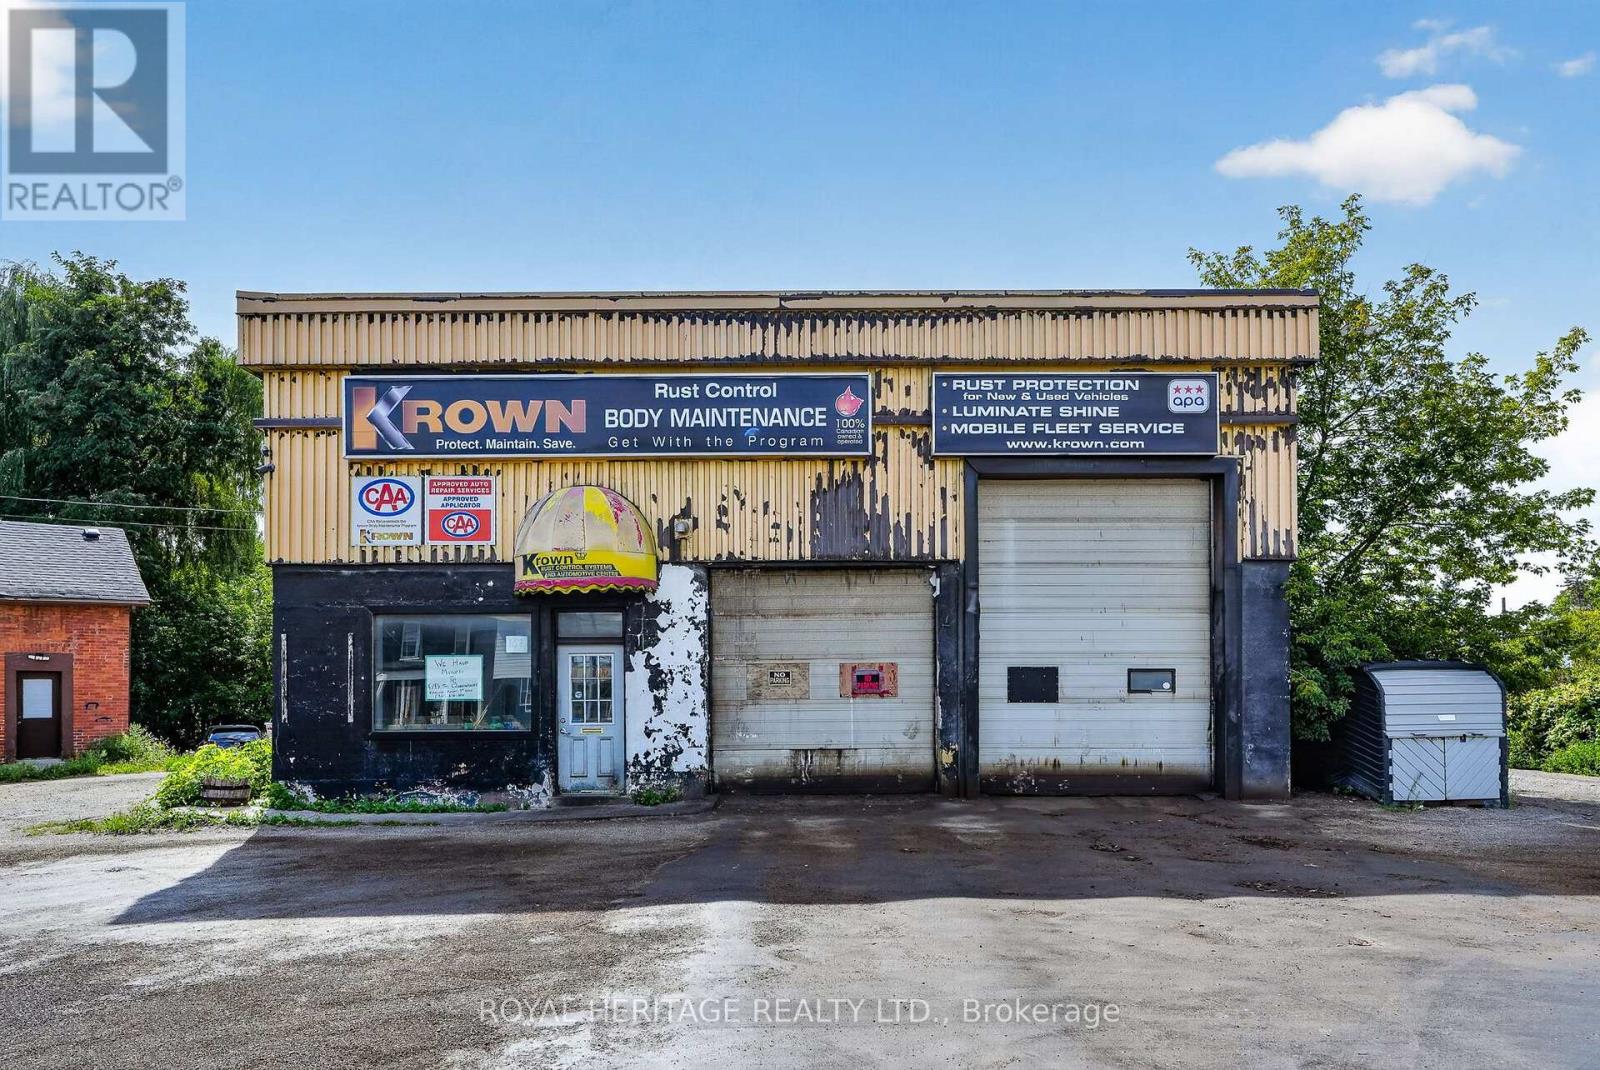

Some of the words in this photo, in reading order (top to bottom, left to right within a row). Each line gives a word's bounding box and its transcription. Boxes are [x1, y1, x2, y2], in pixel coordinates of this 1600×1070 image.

[655, 383, 700, 399] Rust
[705, 383, 777, 399] Control
[952, 380, 1006, 391] RUST
[1013, 379, 1140, 391] PROTECTION
[963, 392, 983, 401] for
[987, 392, 1018, 401] New
[1021, 392, 1032, 401] &
[1036, 392, 1069, 401] Used
[1074, 392, 1129, 401] Vehicles
[1173, 395, 1205, 408] apa
[352, 385, 587, 451] KROWN
[604, 408, 663, 428] BODY
[671, 407, 827, 428] MAINTENANCE
[952, 406, 1052, 417] LUMINATE
[1059, 406, 1120, 417] SHINE
[836, 418, 866, 429] 100%
[951, 423, 1026, 434] MOBILE
[1033, 423, 1092, 434] FLEET
[1099, 423, 1185, 434] SERVICE
[436, 438, 483, 450] Protect.
[486, 438, 541, 450] Maintain.
[543, 438, 577, 450] Save.
[608, 436, 639, 448] Get
[653, 436, 693, 448] With
[706, 436, 734, 447] the
[748, 436, 824, 449] Program
[1006, 438, 1145, 449] www.krown.com
[365, 483, 407, 511] CAA
[446, 515, 475, 533] CAA
[522, 553, 573, 576] Krown
